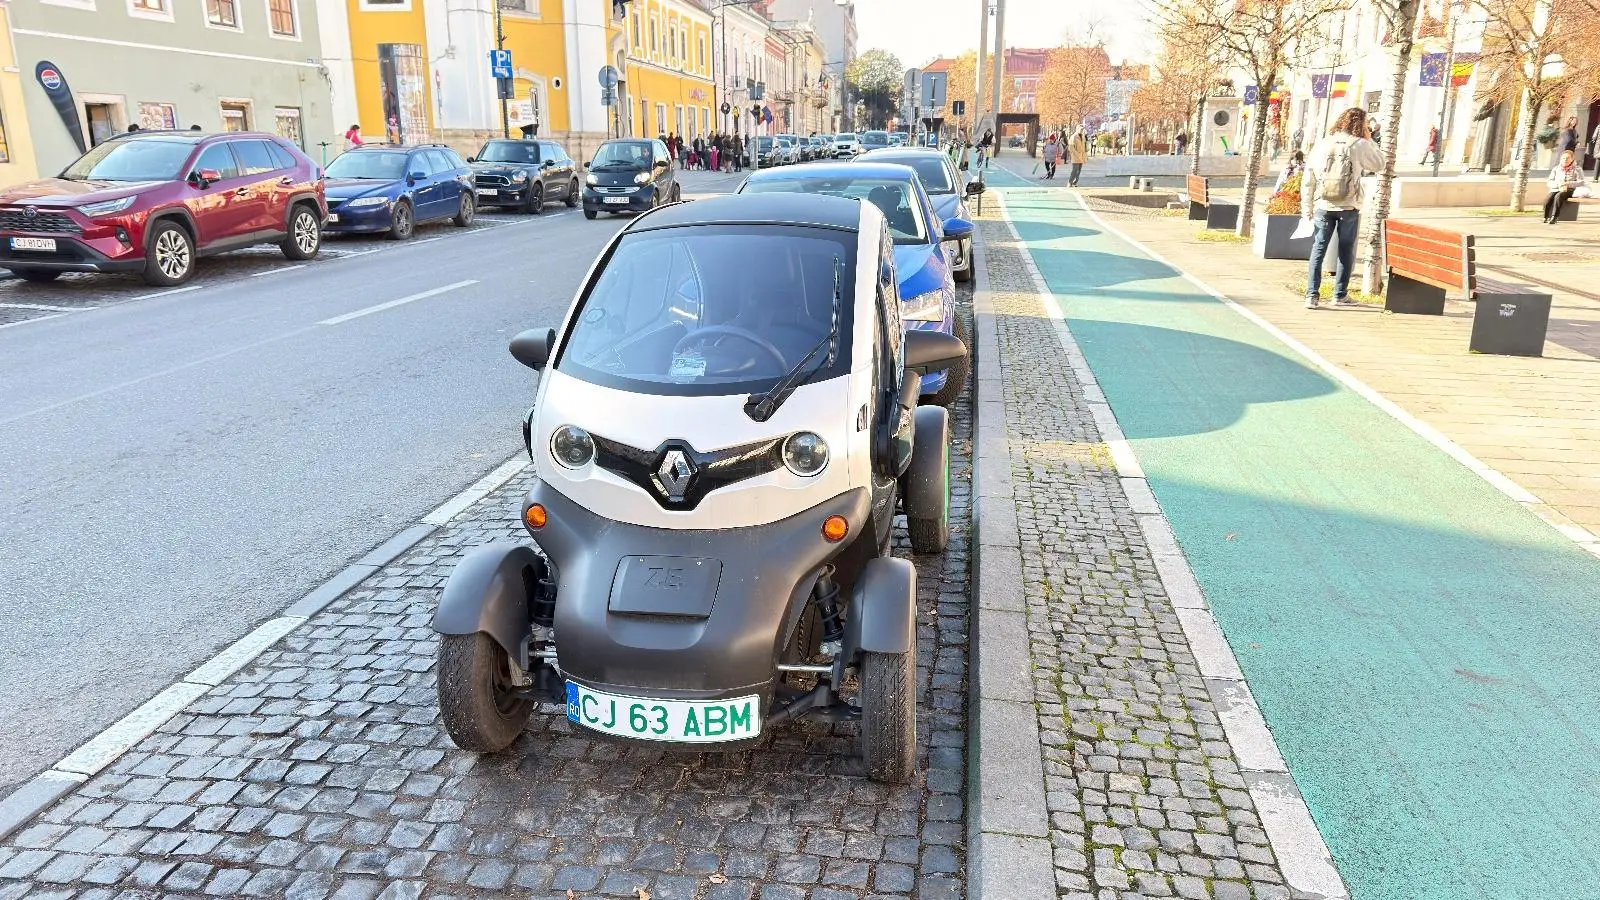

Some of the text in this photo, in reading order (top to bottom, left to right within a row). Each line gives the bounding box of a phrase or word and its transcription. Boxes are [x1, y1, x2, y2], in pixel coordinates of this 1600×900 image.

[496, 51, 506, 66] P
[569, 702, 580, 717] RO
[582, 694, 751, 736] CJ 63 ABM
